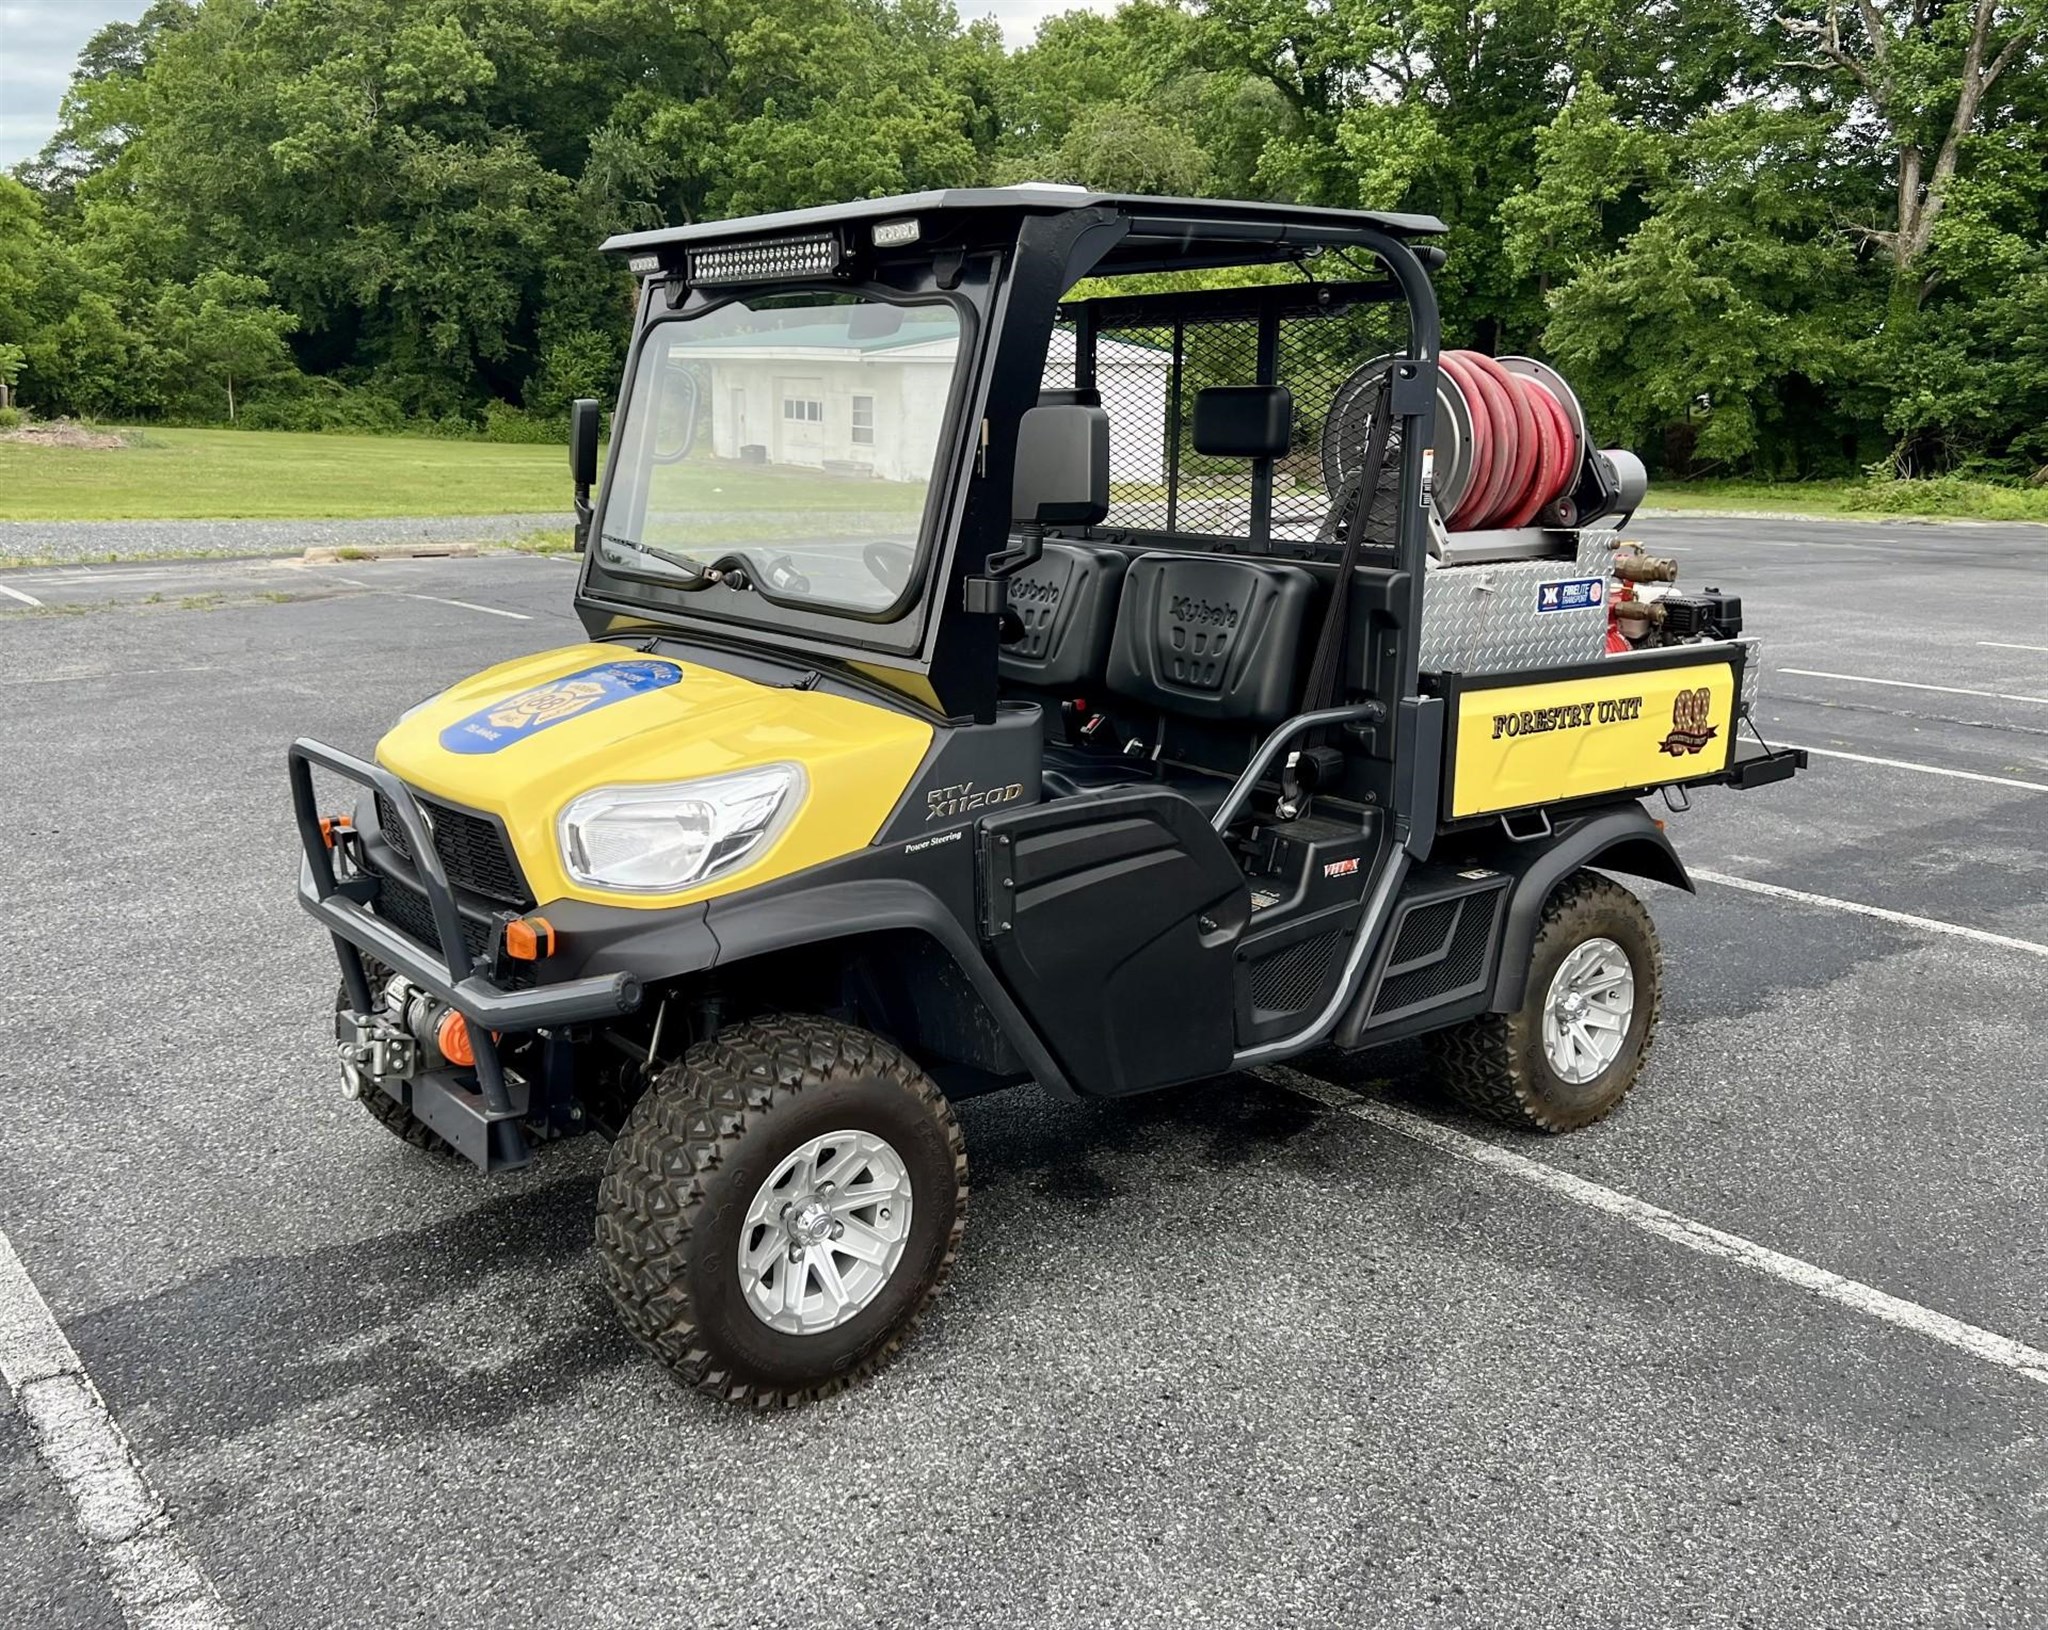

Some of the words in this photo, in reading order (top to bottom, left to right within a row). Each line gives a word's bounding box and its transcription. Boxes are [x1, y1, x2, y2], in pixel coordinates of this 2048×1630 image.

[1009, 577, 1059, 604] Kubota
[1169, 595, 1238, 629] Kubota
[1492, 704, 1594, 739] FORESTRY
[1596, 696, 1643, 724] UNIT
[925, 783, 1024, 821] X1120D
[927, 782, 974, 803] RTV
[905, 840, 930, 854] Power
[930, 832, 962, 847] Steering
